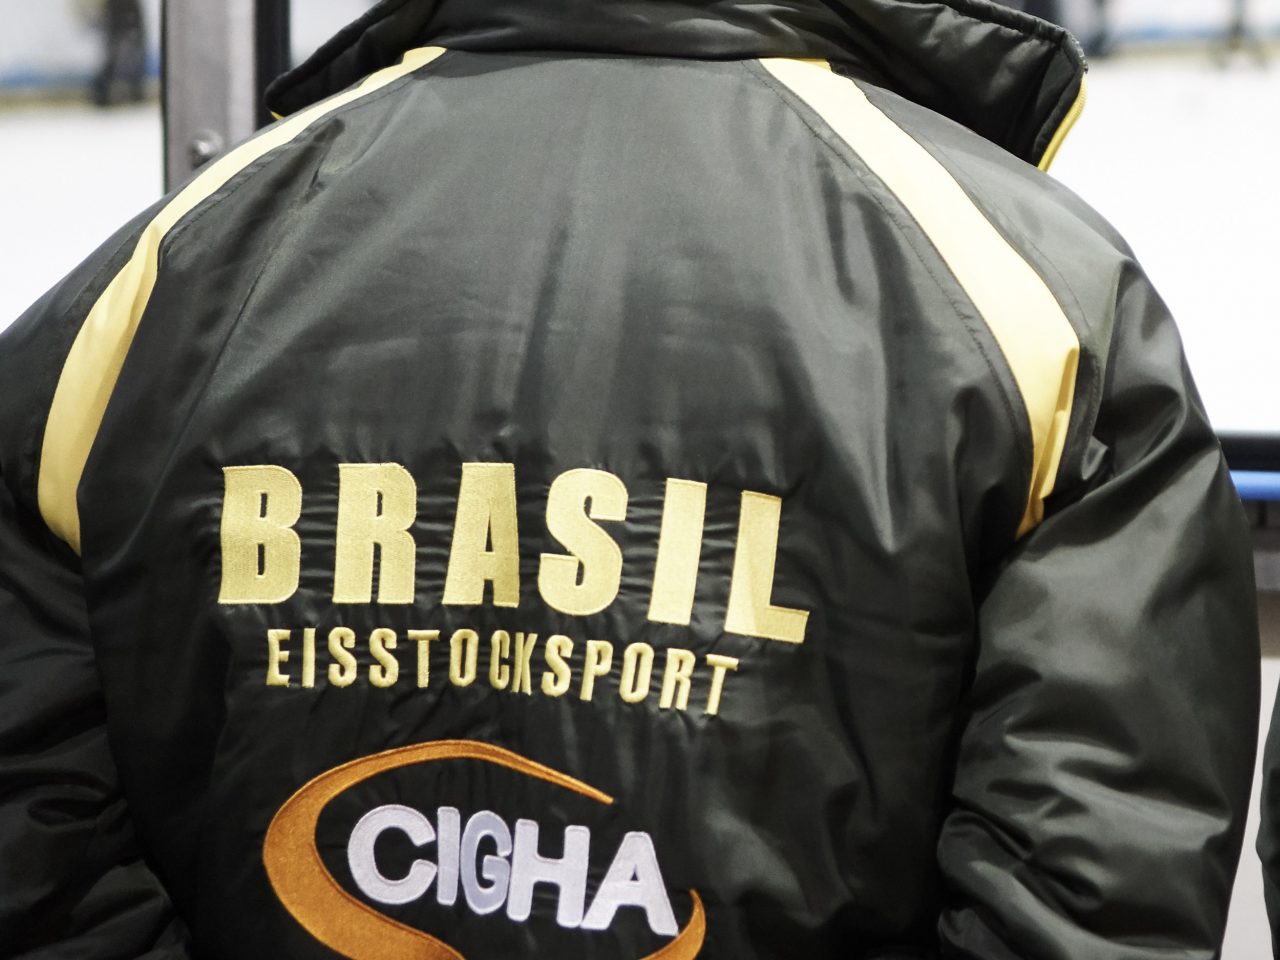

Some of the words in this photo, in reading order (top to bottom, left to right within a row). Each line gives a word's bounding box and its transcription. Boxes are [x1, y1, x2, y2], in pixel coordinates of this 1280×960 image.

[217, 461, 810, 644] BRASIL
[266, 626, 739, 716] EISSTOCKSPORT
[347, 803, 680, 936] CIGHA
